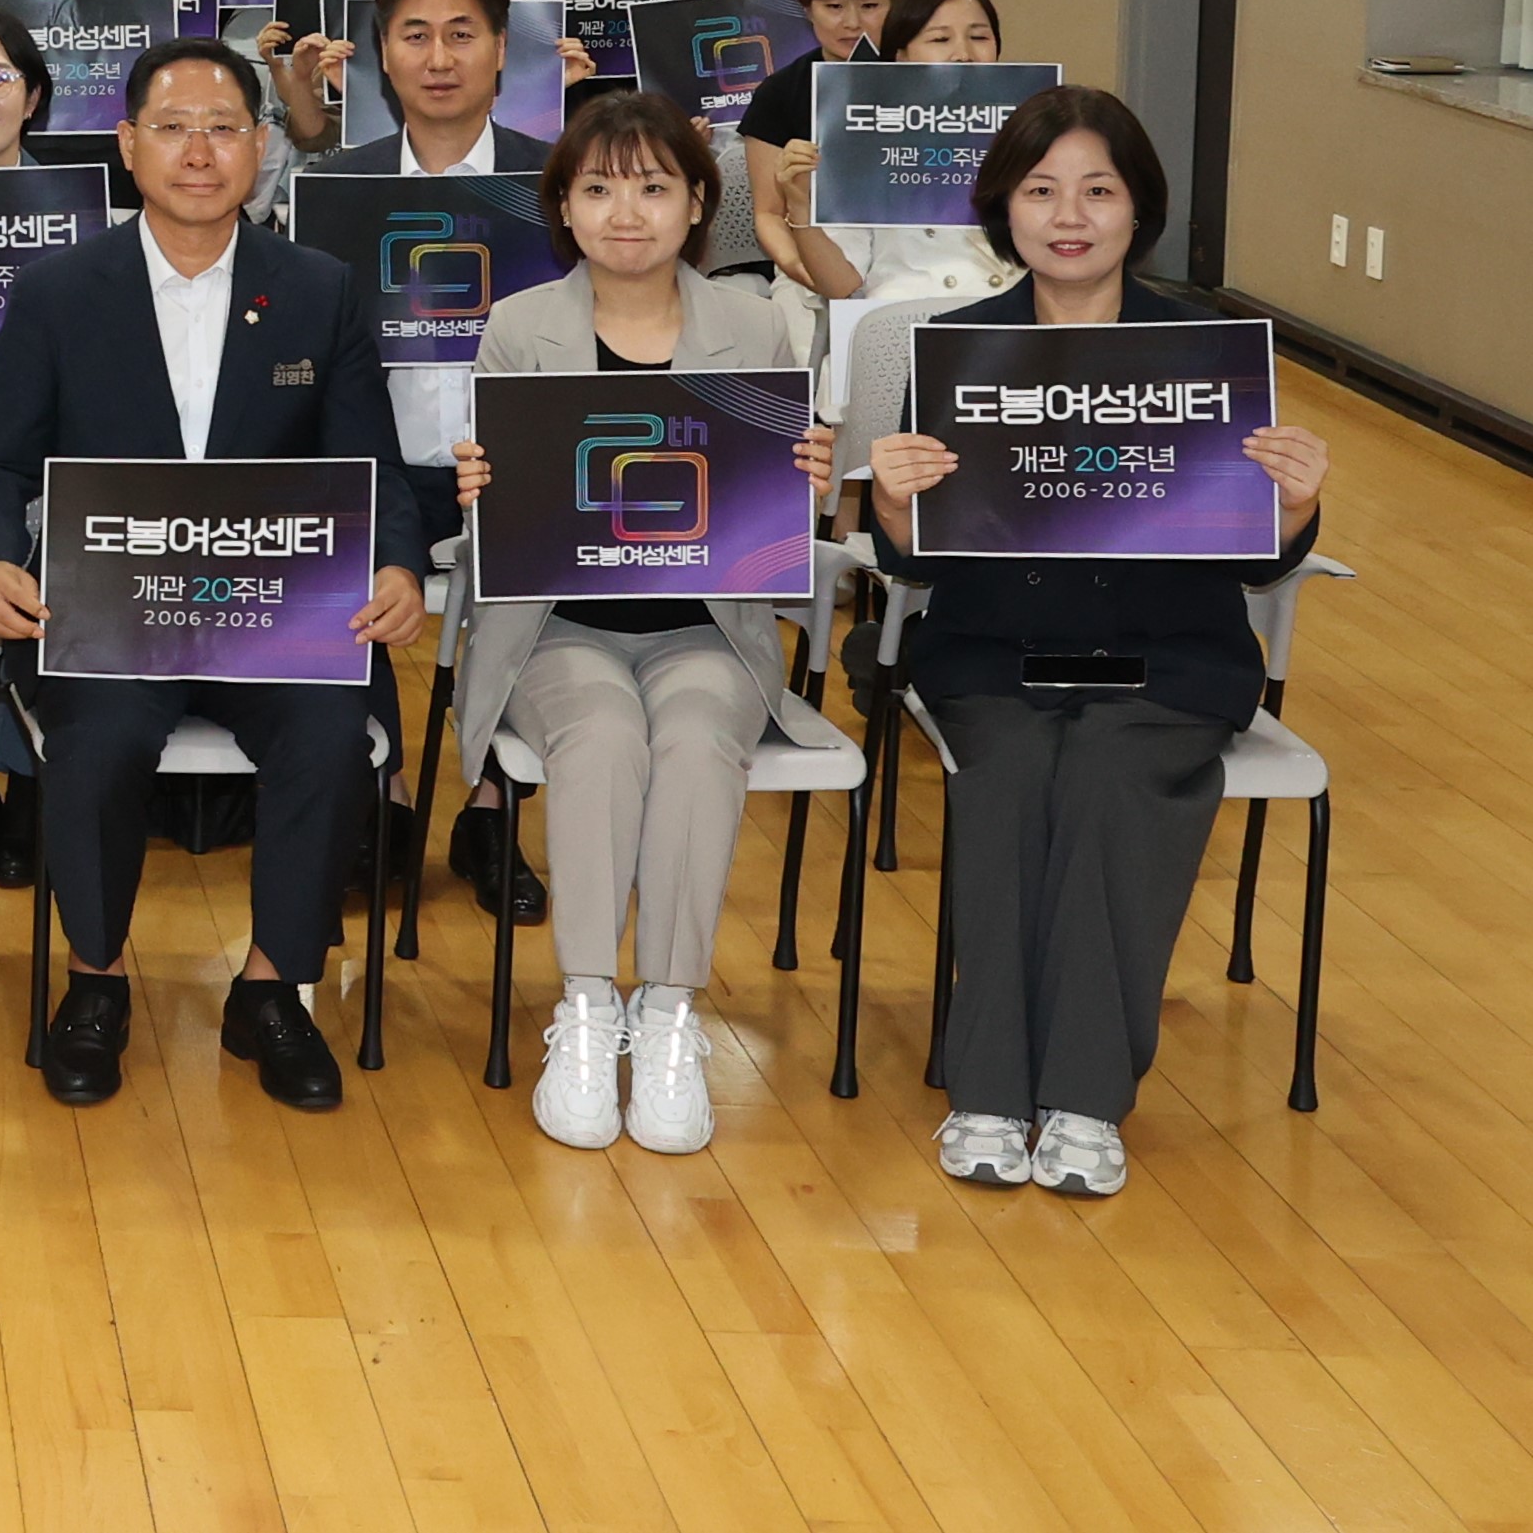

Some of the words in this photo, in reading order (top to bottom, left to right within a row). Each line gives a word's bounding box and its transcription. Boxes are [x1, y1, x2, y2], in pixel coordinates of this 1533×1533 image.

[578, 21, 605, 35] 개관
[65, 62, 121, 81] 20주년
[700, 92, 755, 111] 도봉여성
[881, 147, 920, 168] 개관
[889, 172, 978, 185] 2006-202
[954, 382, 1231, 425] 도봉여성센터
[1010, 446, 1068, 474] 개관
[1074, 445, 1176, 474] 20주년
[1023, 482, 1167, 499] 2006-2026
[84, 516, 334, 557] 도봉여성센터
[577, 545, 709, 567] 도봉여성센터
[132, 575, 186, 602] 개관
[191, 576, 284, 605] 20주년
[143, 610, 274, 629] 2006-2026
